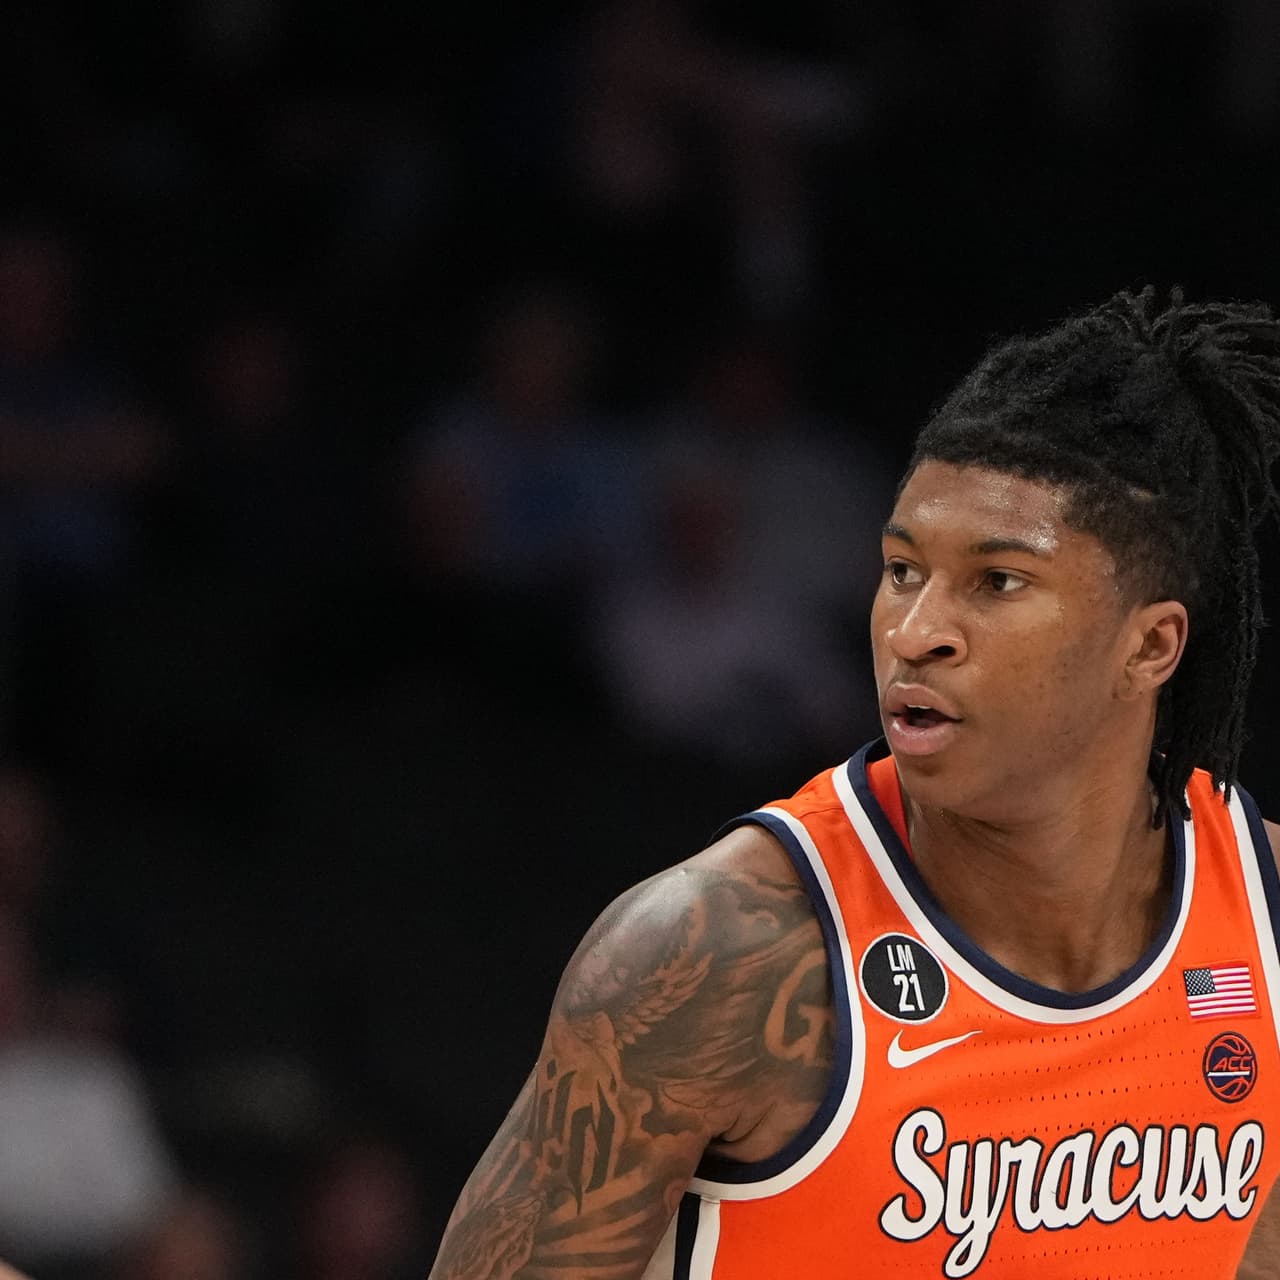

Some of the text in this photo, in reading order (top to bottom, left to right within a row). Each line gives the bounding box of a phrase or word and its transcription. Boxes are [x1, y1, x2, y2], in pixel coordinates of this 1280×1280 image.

[887, 945, 916, 972] LM
[893, 973, 926, 1012] 21
[1213, 1055, 1253, 1072] ACC
[878, 1106, 1264, 1280] Syracuse
